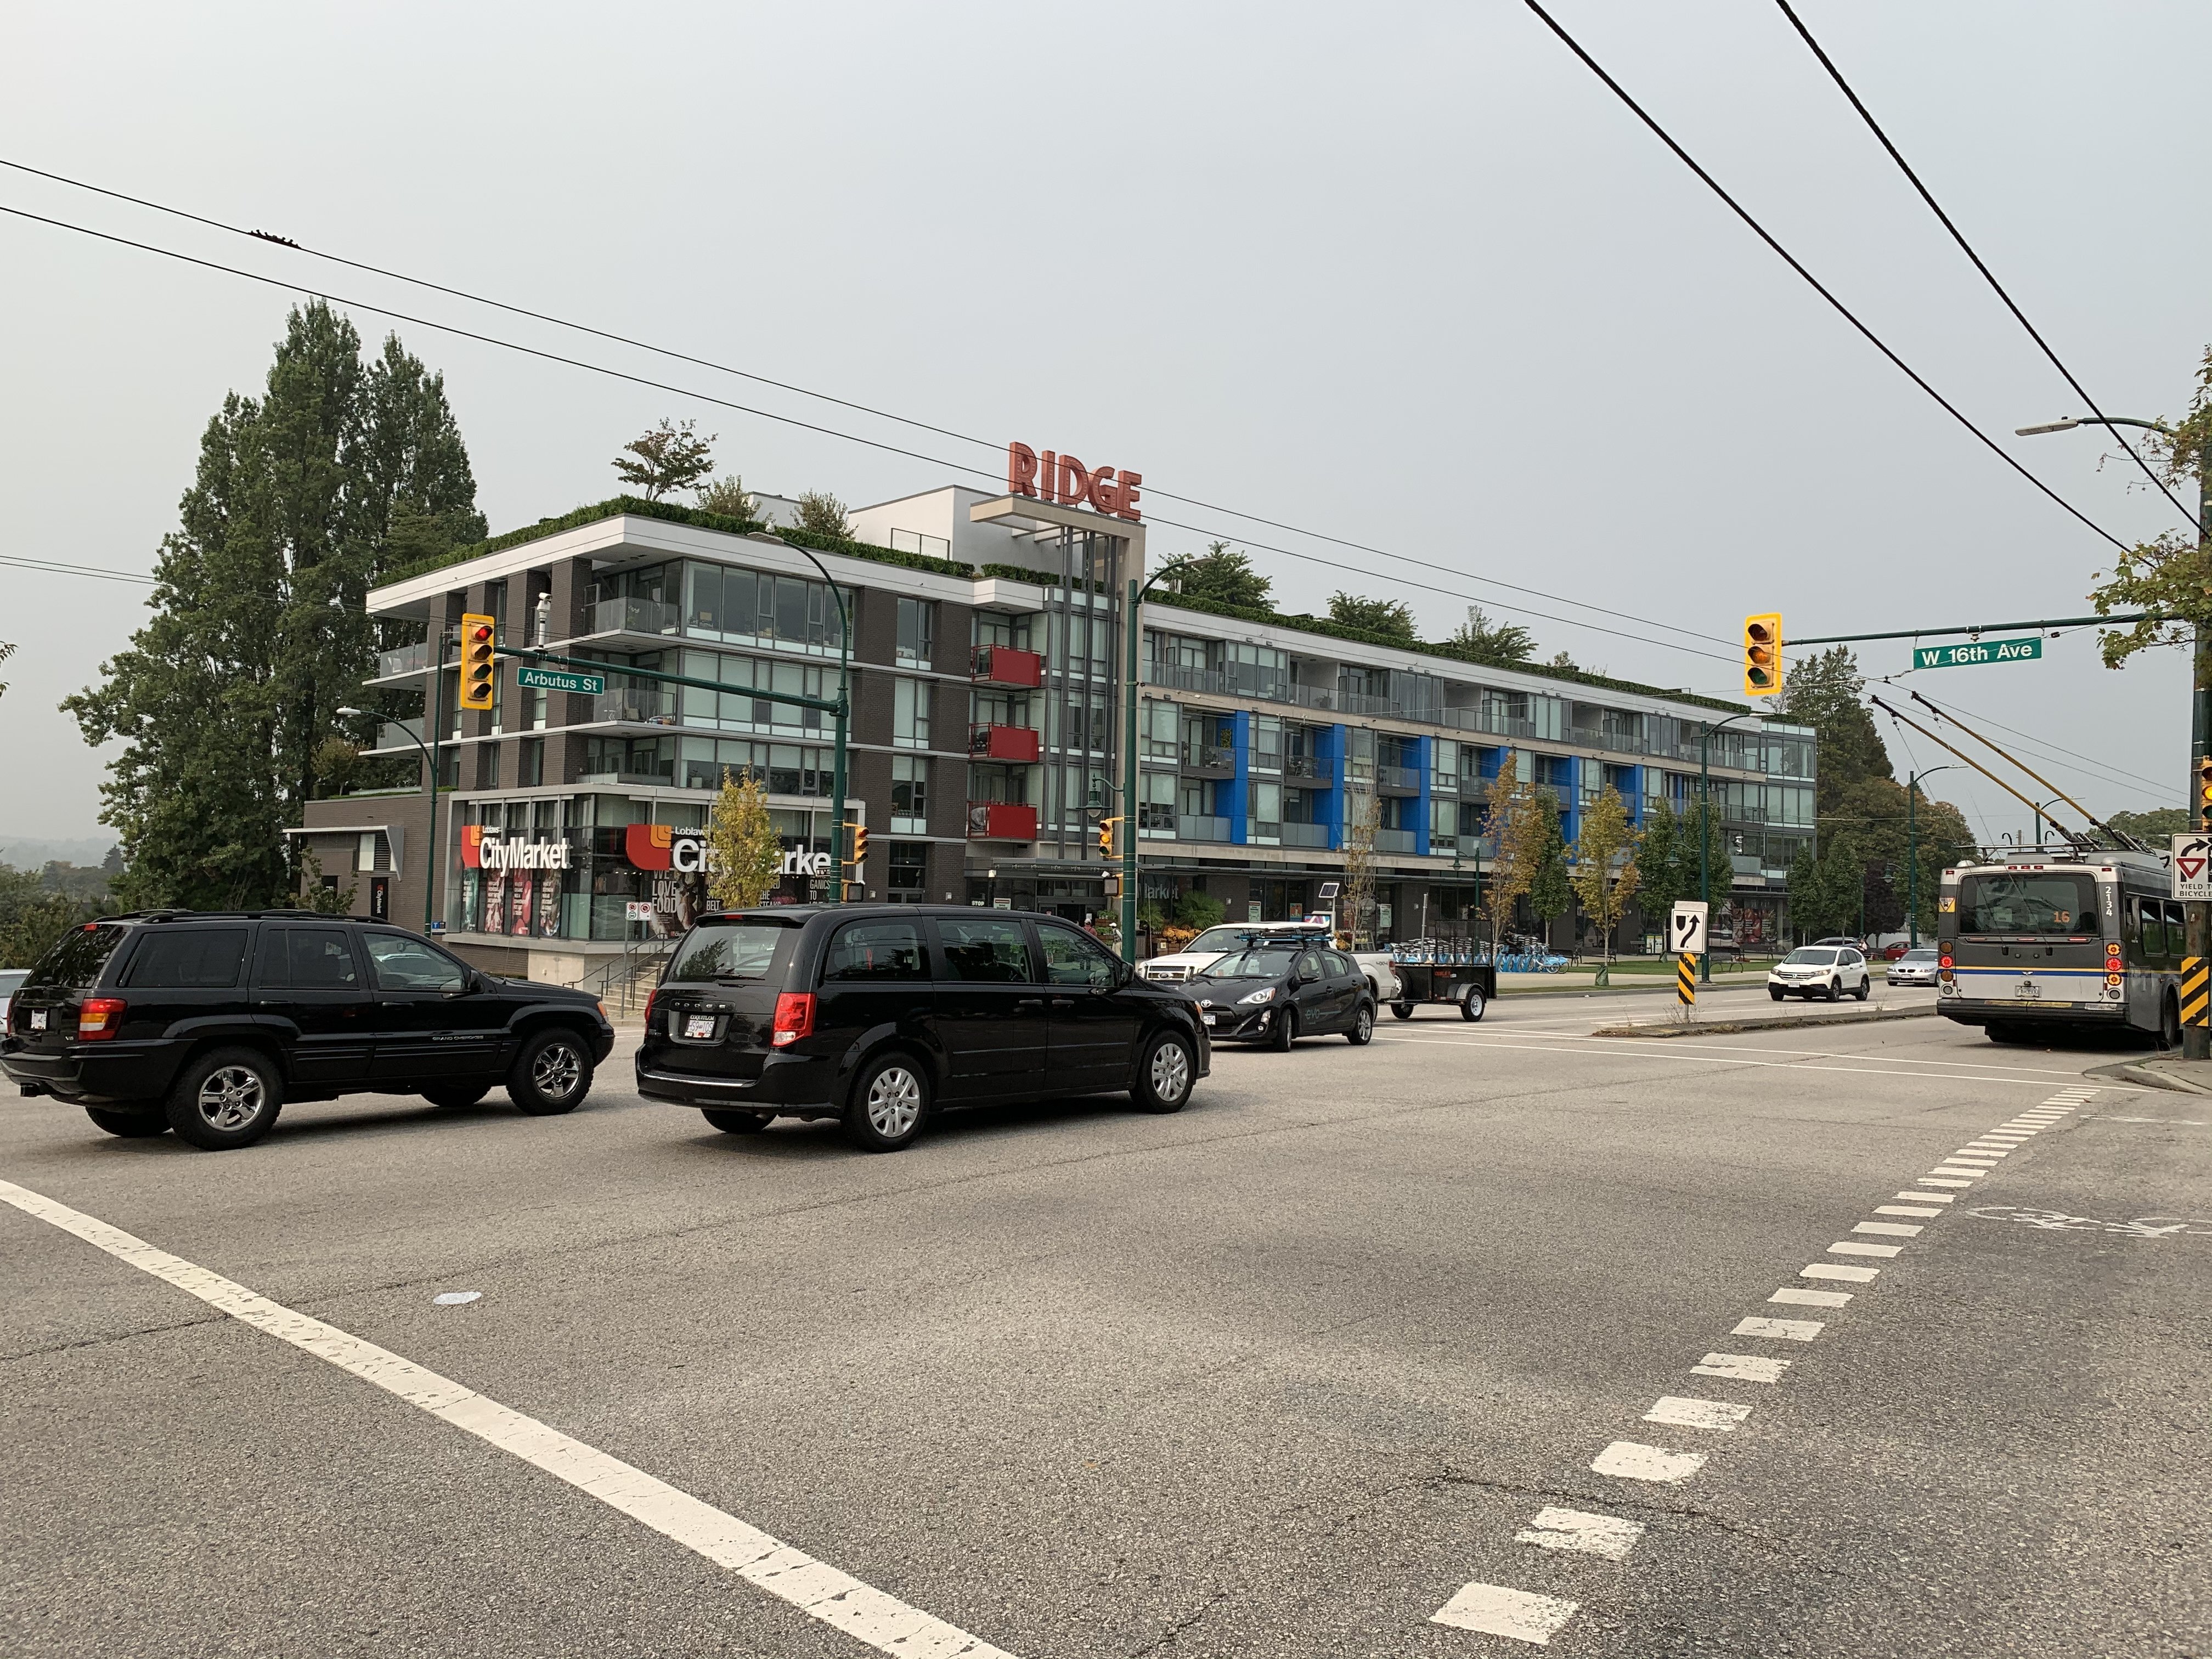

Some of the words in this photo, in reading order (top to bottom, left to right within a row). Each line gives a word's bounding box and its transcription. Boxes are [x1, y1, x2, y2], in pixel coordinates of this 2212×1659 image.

[1009, 442, 1142, 521] RIDGE
[1922, 650, 1940, 665] W
[1948, 646, 1988, 663] 16th
[1997, 644, 2033, 659] Ave
[524, 672, 577, 689] Arbutus
[583, 678, 597, 691] St
[675, 826, 710, 836] Loblaw
[480, 836, 568, 878] CityMarket
[652, 880, 677, 896] LOVE
[810, 879, 830, 889] GANICS
[809, 890, 817, 900] TO
[651, 897, 677, 913] FOOD
[707, 900, 721, 911] BELT
[2053, 911, 2070, 923] 16
